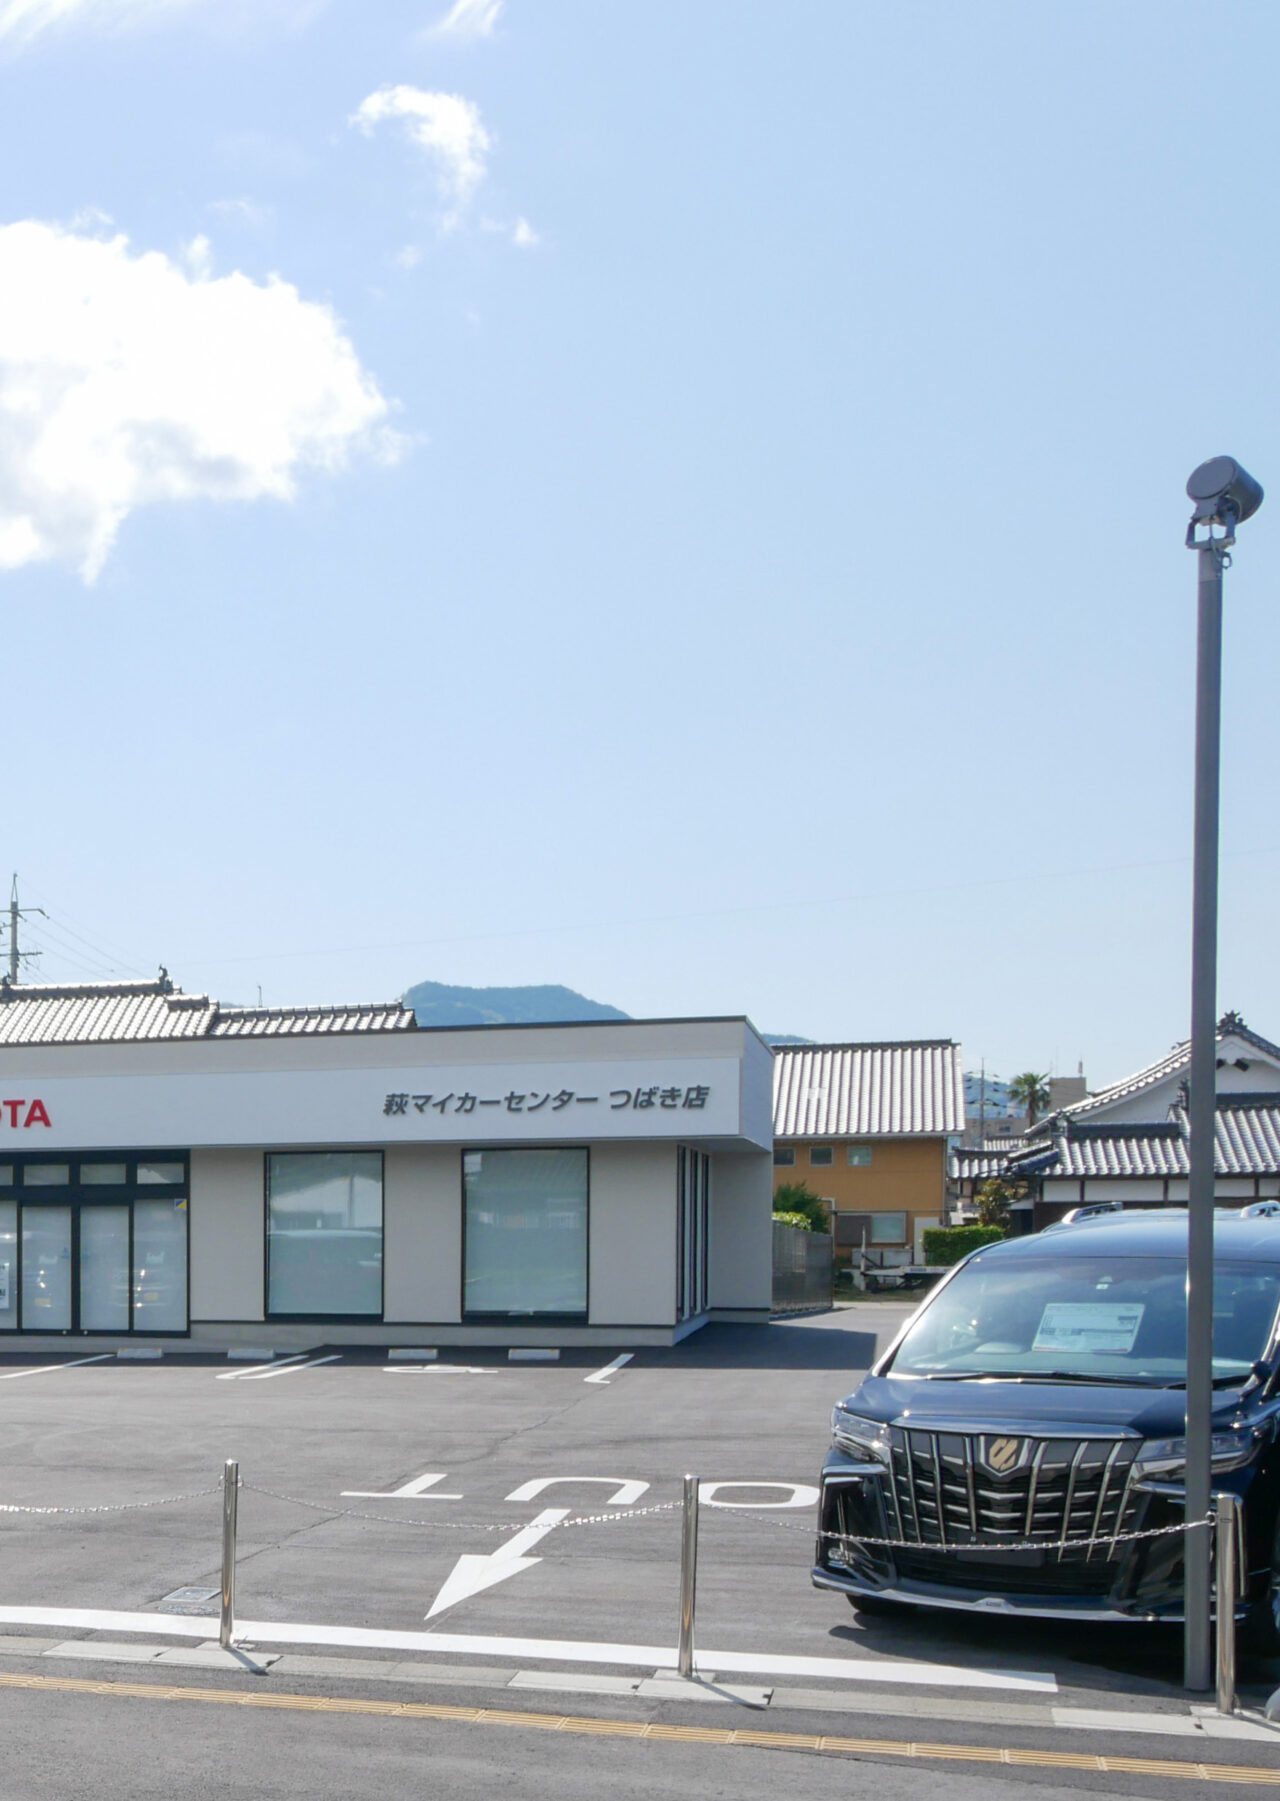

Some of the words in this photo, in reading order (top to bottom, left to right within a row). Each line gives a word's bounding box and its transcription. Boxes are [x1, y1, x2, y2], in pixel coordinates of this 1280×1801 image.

[382, 1089, 599, 1116] 萩マイカーセンター
[609, 1085, 710, 1110] つばき店
[340, 1473, 821, 1508] OUT
